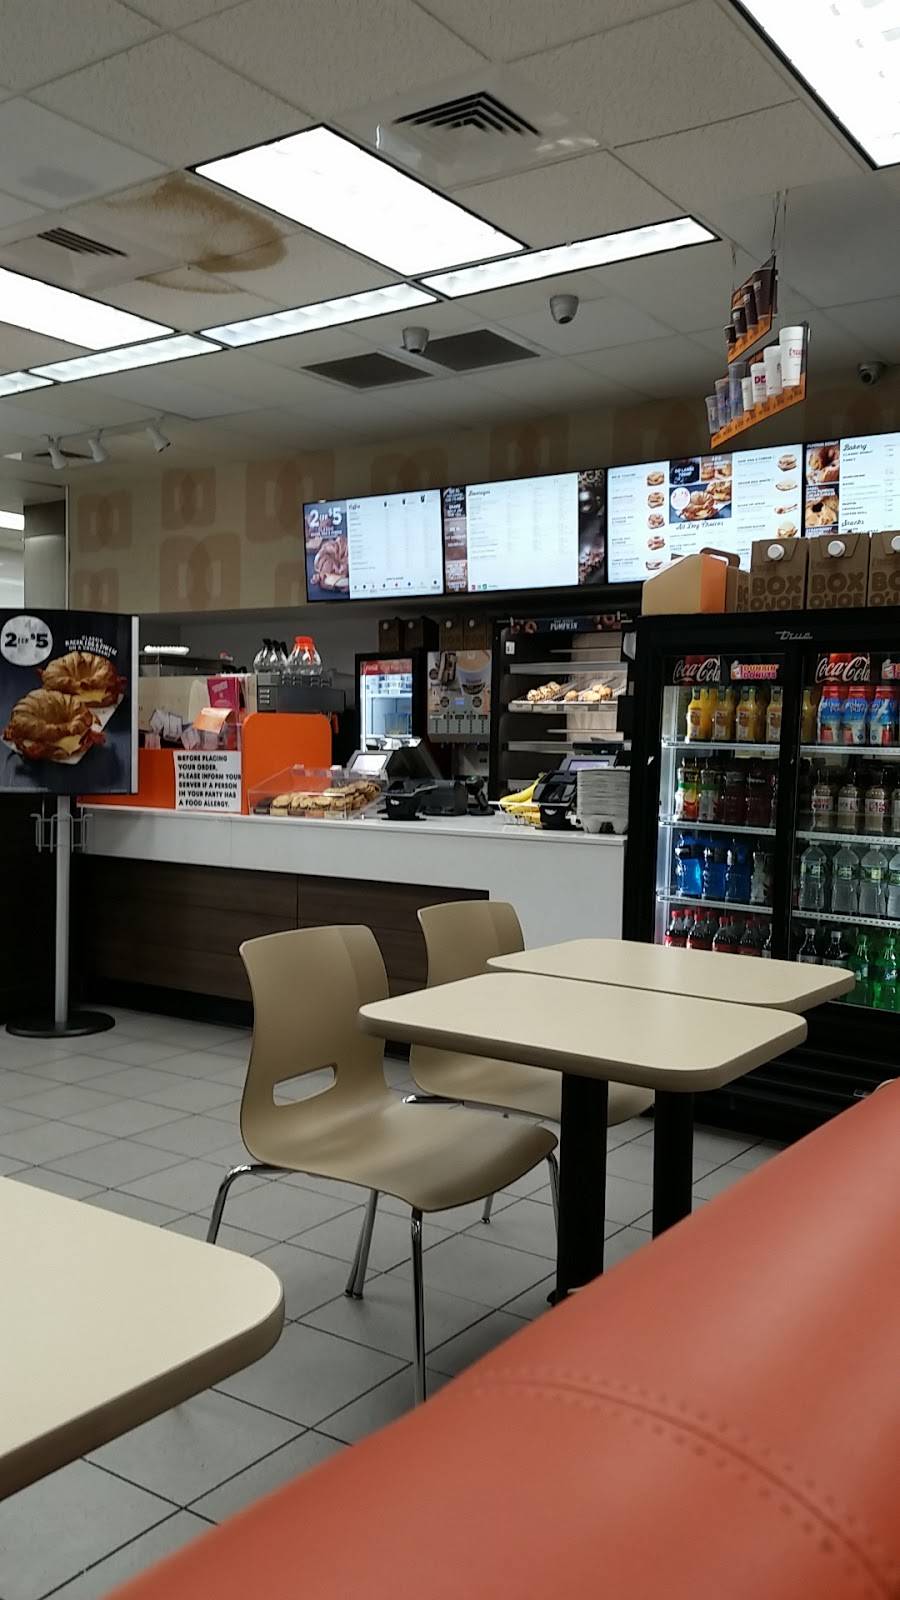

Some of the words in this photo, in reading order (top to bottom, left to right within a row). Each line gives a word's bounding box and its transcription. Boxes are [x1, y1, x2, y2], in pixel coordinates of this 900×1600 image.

[309, 509, 320, 528] 2
[752, 575, 802, 596] BOX
[811, 572, 865, 594] BOX
[750, 595, 802, 611] O'JOE
[809, 592, 865, 609] O'JOE
[550, 622, 578, 631] PUMPKIN
[4, 632, 17, 648] 2
[30, 632, 49, 649] $5
[673, 657, 720, 684] Coca-Cola
[742, 672, 777, 680] DONUTS
[815, 656, 870, 684] Coca-Cola
